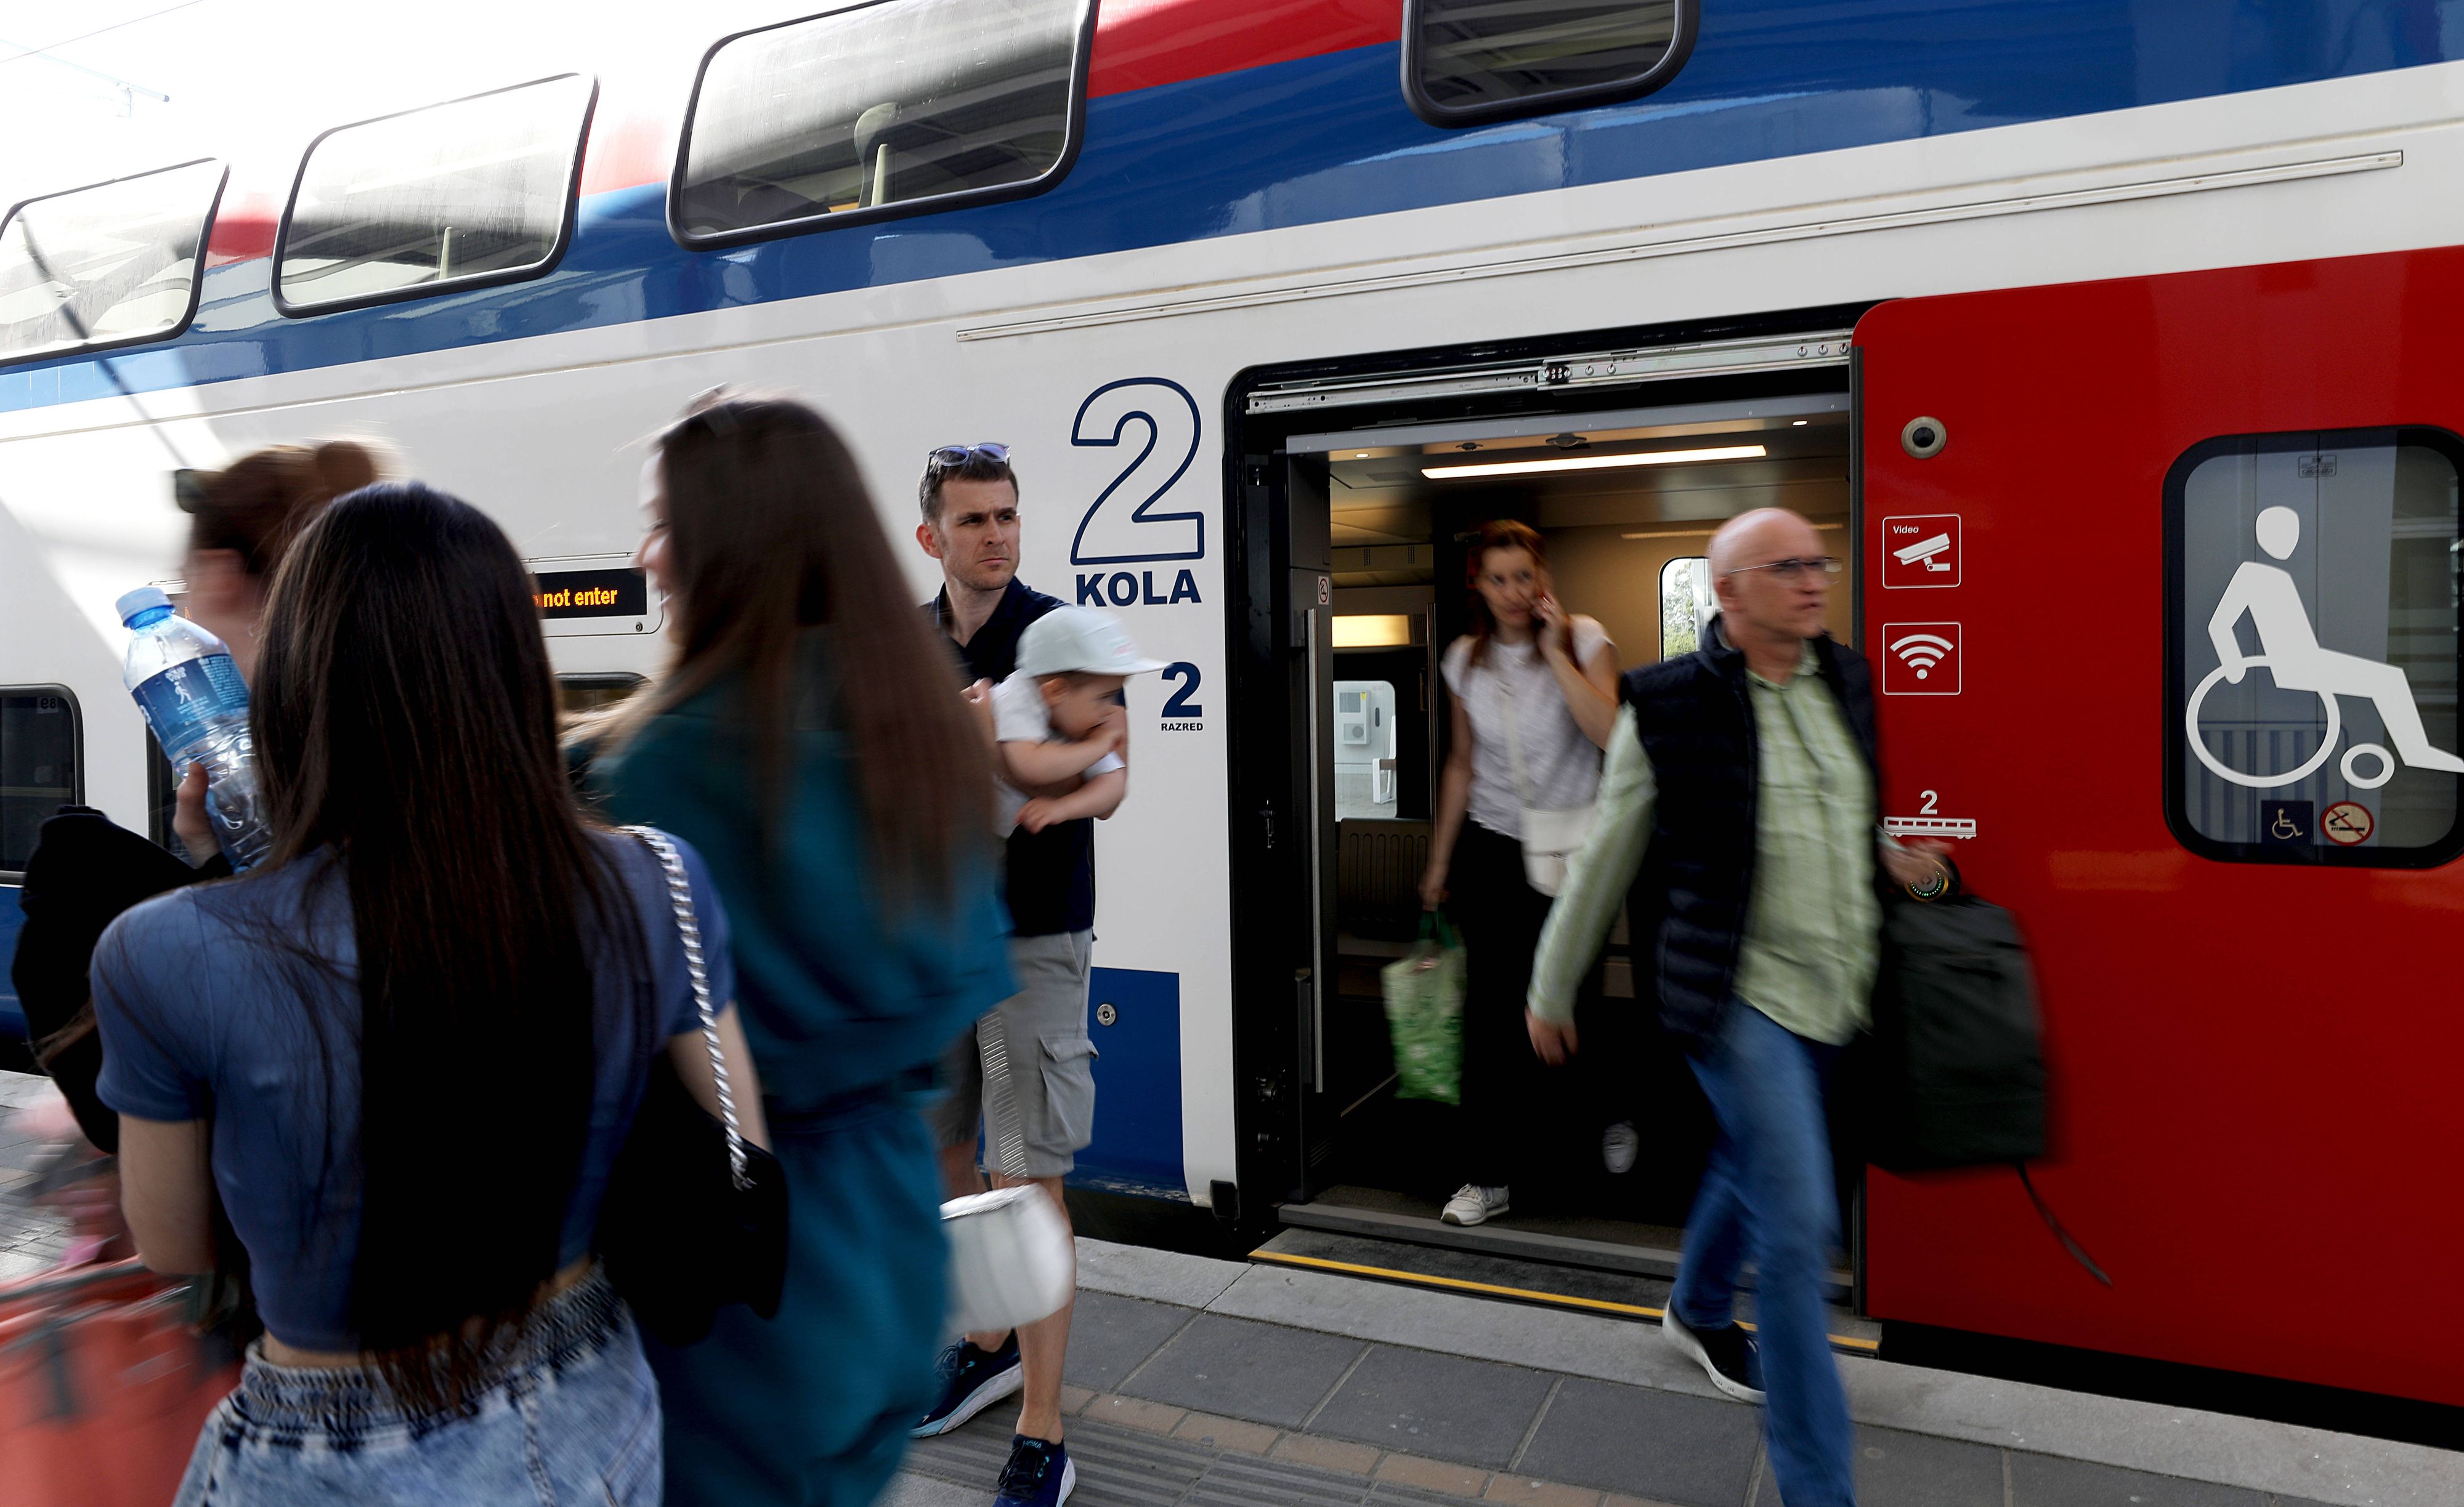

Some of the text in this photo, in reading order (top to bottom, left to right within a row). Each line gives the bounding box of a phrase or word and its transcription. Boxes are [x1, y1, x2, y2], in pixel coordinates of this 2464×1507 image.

[1071, 377, 1205, 565] 2
[1893, 525, 1919, 534] Video
[543, 589, 570, 607] not
[575, 587, 617, 605] enter
[1076, 569, 1202, 607] KOLA
[1161, 662, 1202, 717] 2
[1161, 723, 1203, 731] RAZRED
[1920, 790, 1938, 815] 2
